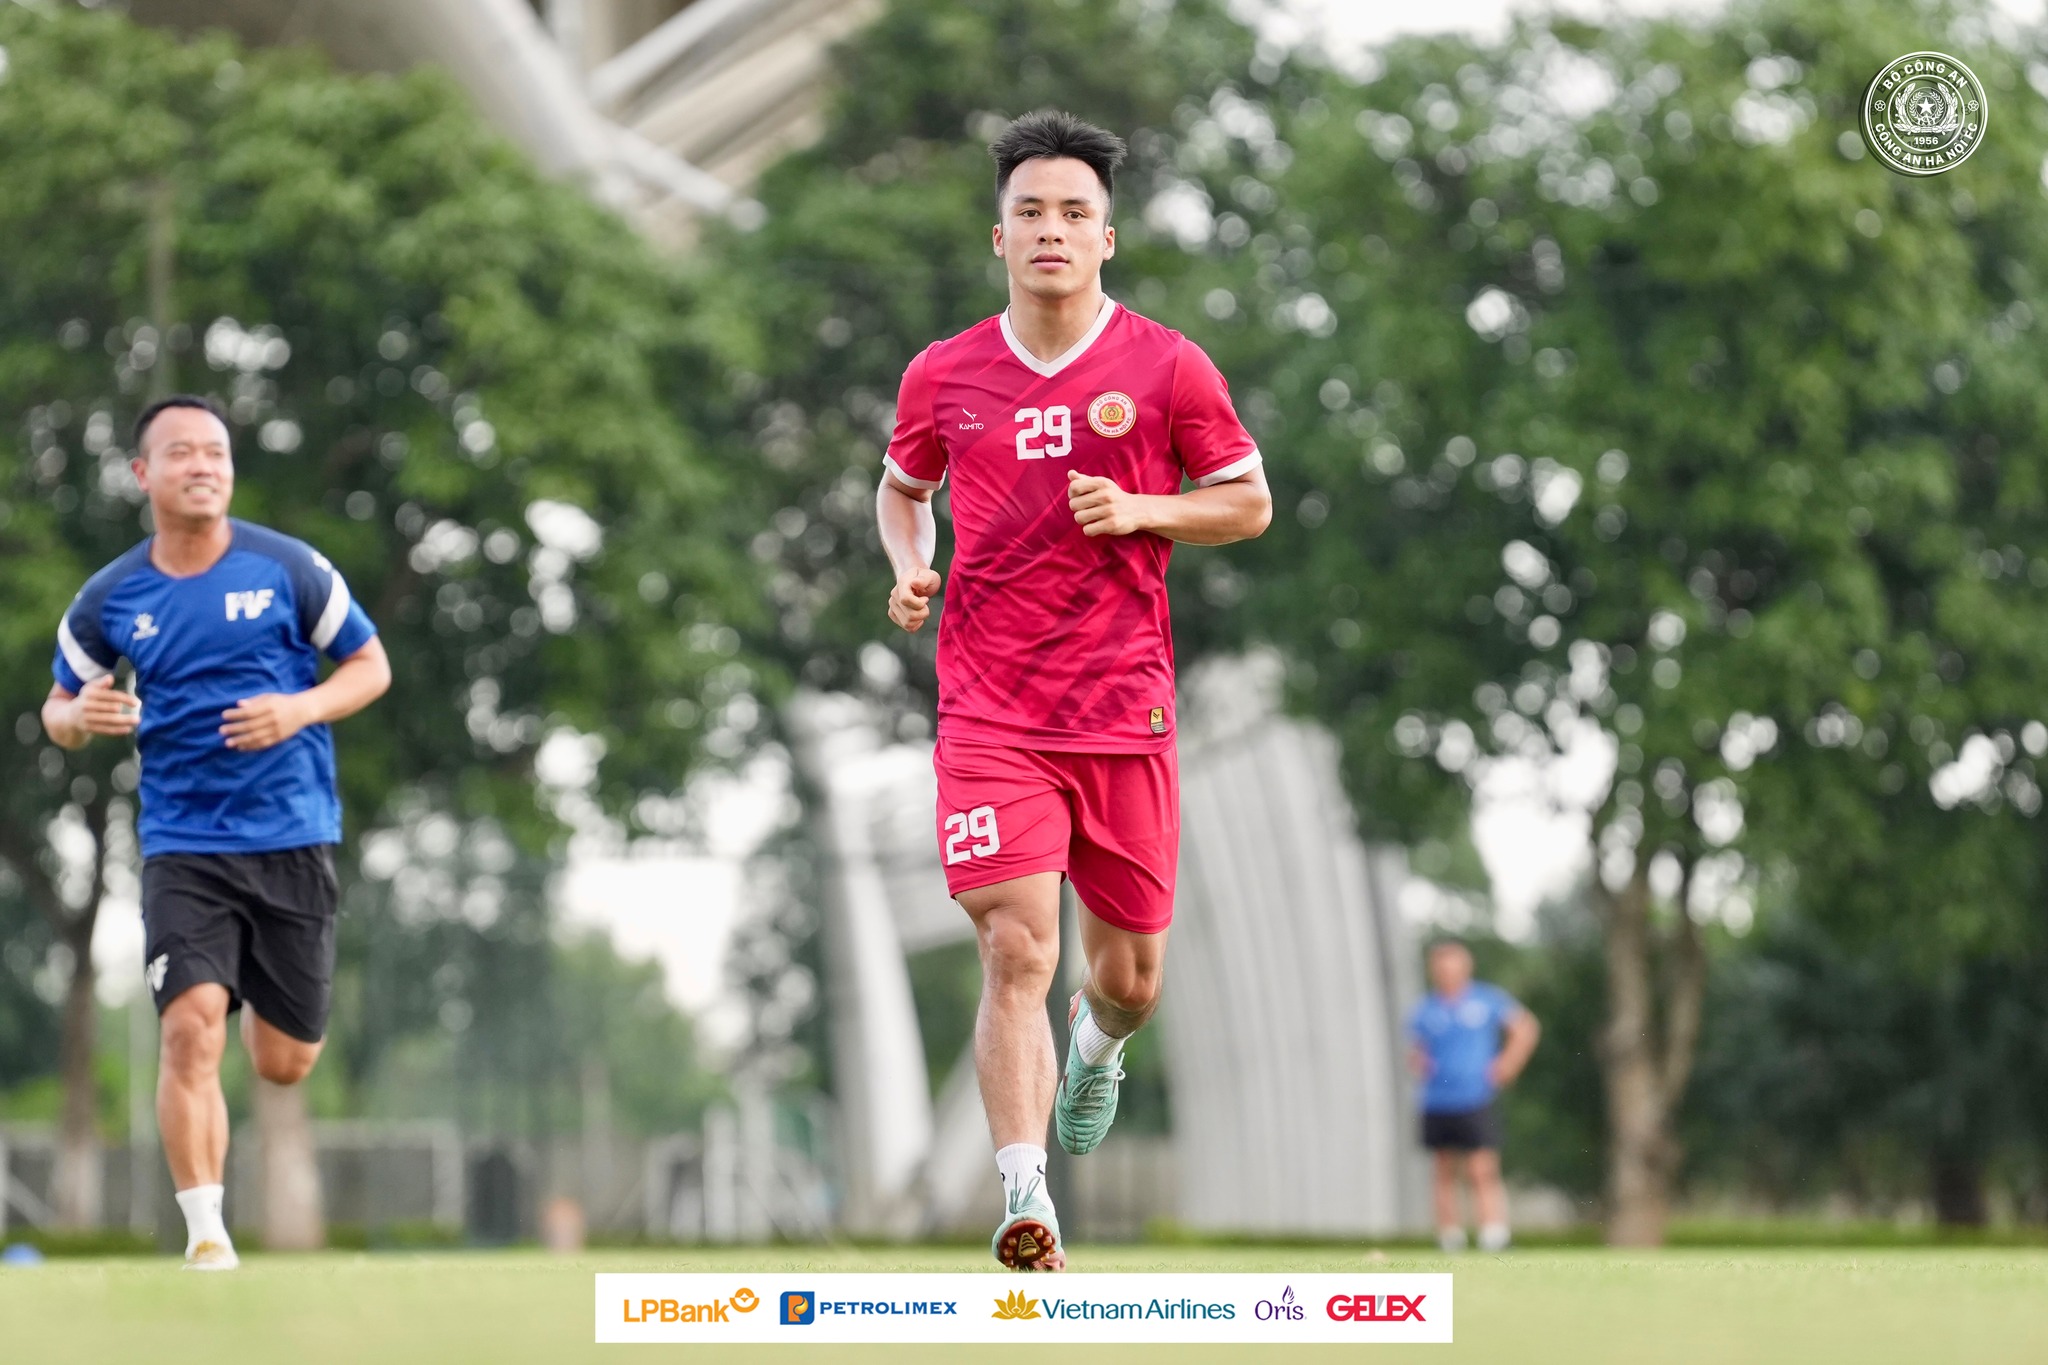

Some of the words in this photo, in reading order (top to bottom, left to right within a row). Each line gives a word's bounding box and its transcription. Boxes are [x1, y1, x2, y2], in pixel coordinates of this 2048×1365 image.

[959, 422, 984, 430] KAMITO
[1014, 405, 1072, 460] 29
[944, 805, 1001, 866] 29
